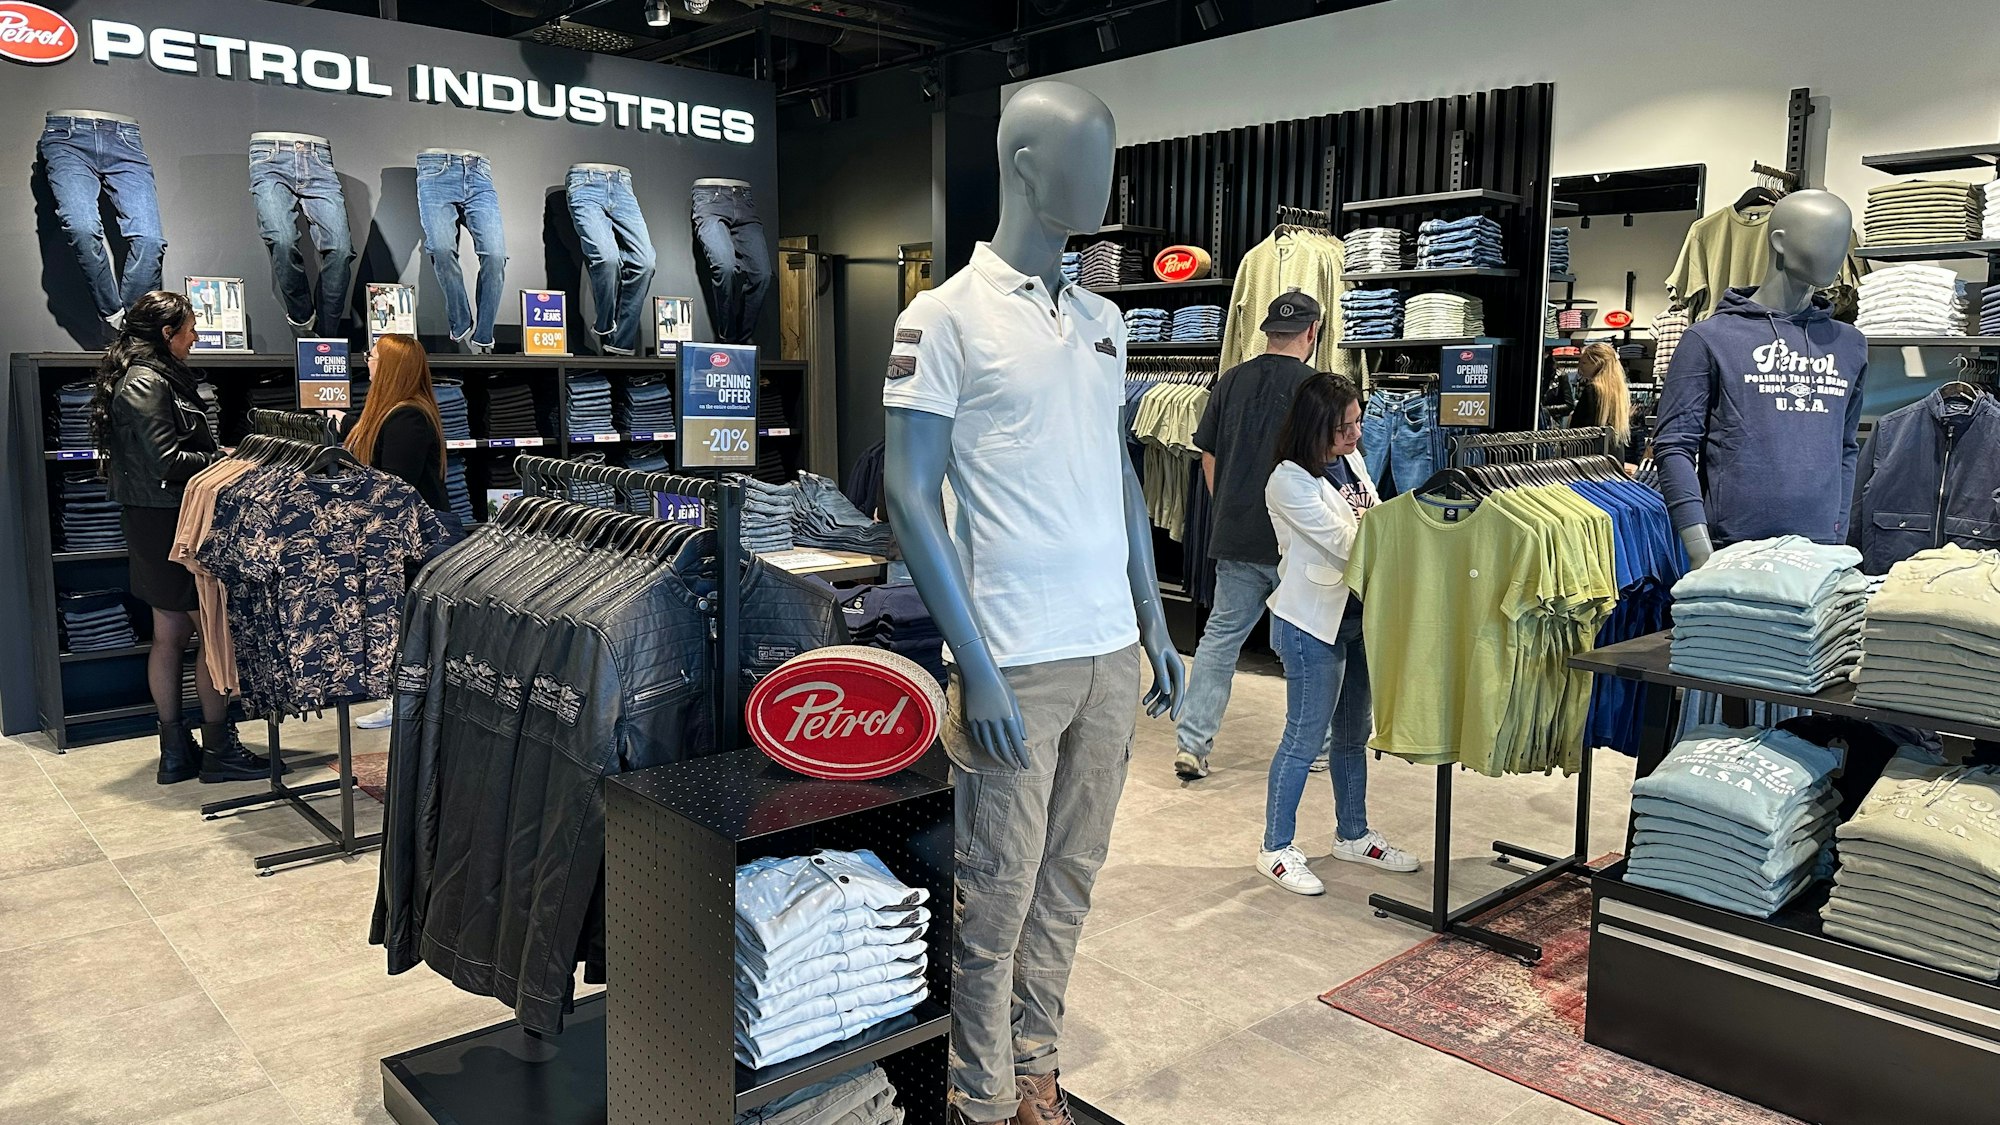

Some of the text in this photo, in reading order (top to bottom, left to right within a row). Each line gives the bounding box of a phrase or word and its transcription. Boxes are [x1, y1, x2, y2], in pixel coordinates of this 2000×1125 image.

[92, 19, 755, 144] PETROL INDUSTRIES
[533, 307, 541, 321] 2
[542, 312, 562, 322] JEANS
[314, 355, 346, 365] OPENING
[323, 364, 347, 374] OFFER
[1456, 364, 1489, 375] OPENING
[706, 373, 751, 389] OPENING
[1464, 374, 1488, 384] OFFER
[314, 386, 347, 401] -20%
[718, 388, 751, 404] OFFER
[1759, 384, 1786, 394] ENJOY
[1817, 385, 1845, 397] HAWAII
[1453, 400, 1486, 416] -20%
[1775, 397, 1829, 413] U.S.A.
[702, 427, 750, 452] -20%
[667, 504, 700, 521] 2 JEANS
[1689, 765, 1757, 796] U.S.A.
